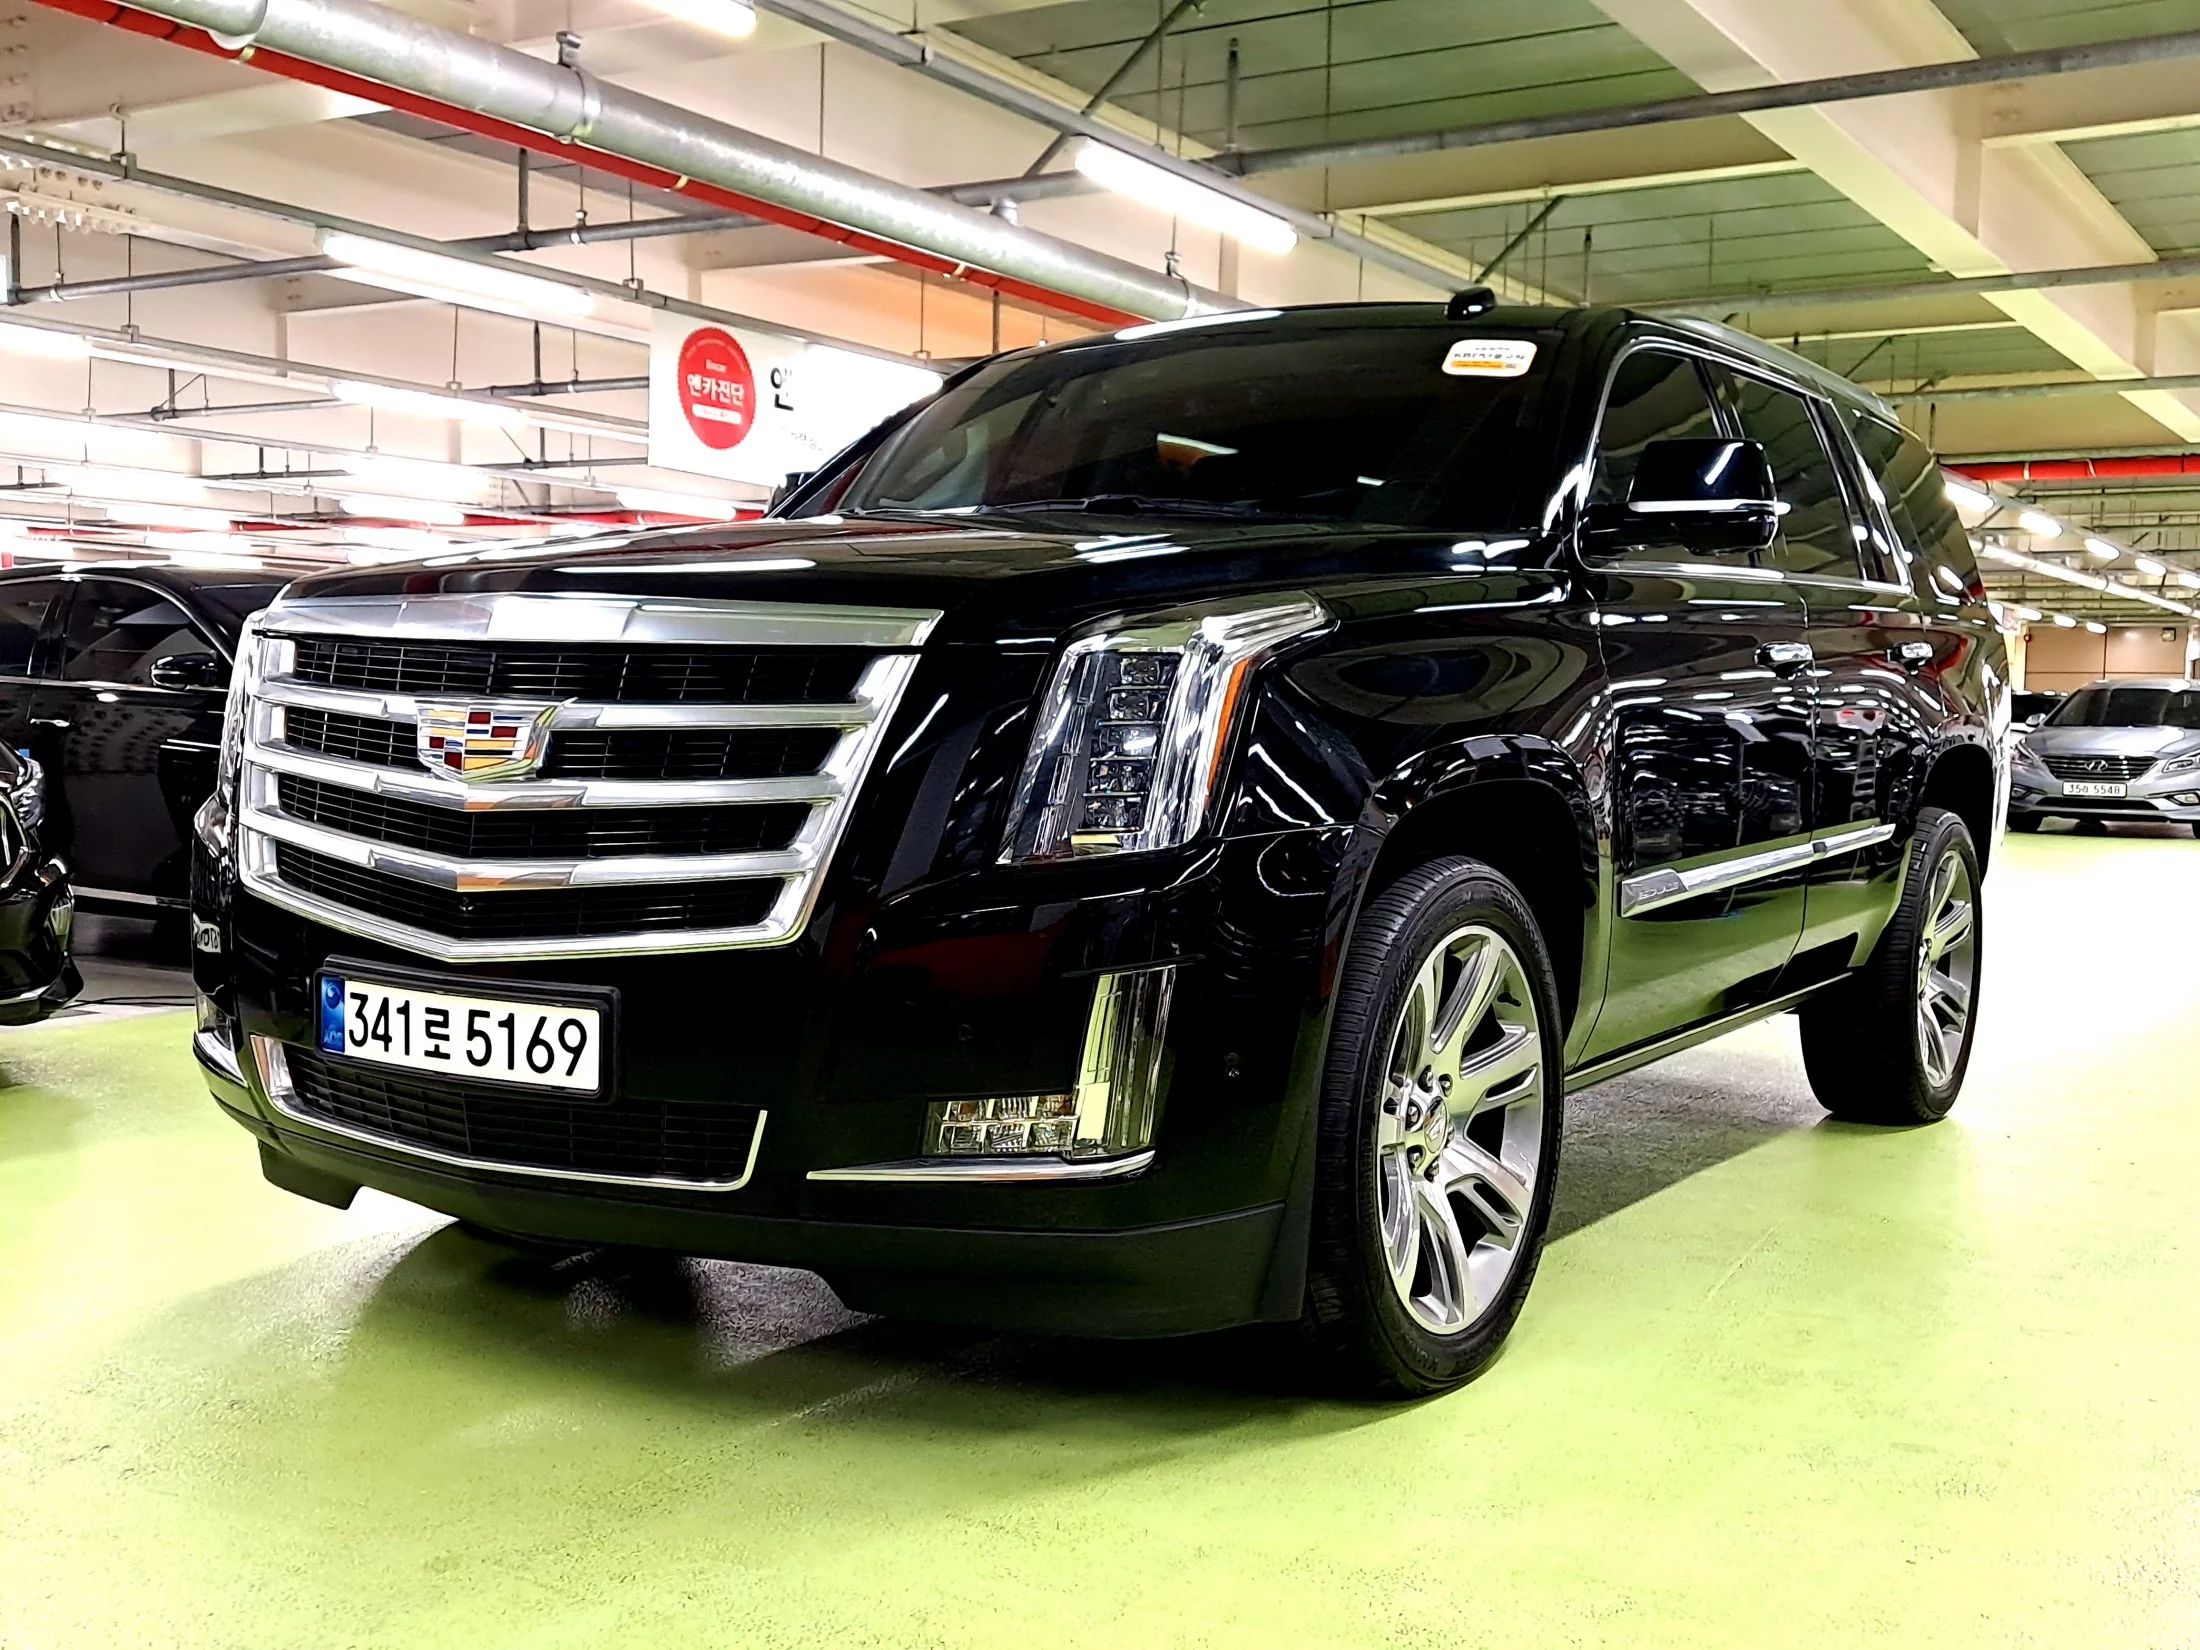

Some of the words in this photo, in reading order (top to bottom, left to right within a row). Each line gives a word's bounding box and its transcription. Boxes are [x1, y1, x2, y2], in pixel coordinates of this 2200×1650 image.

[686, 372, 745, 407] 엔카진단
[348, 991, 451, 1060] 341로
[465, 1009, 588, 1077] 5169
